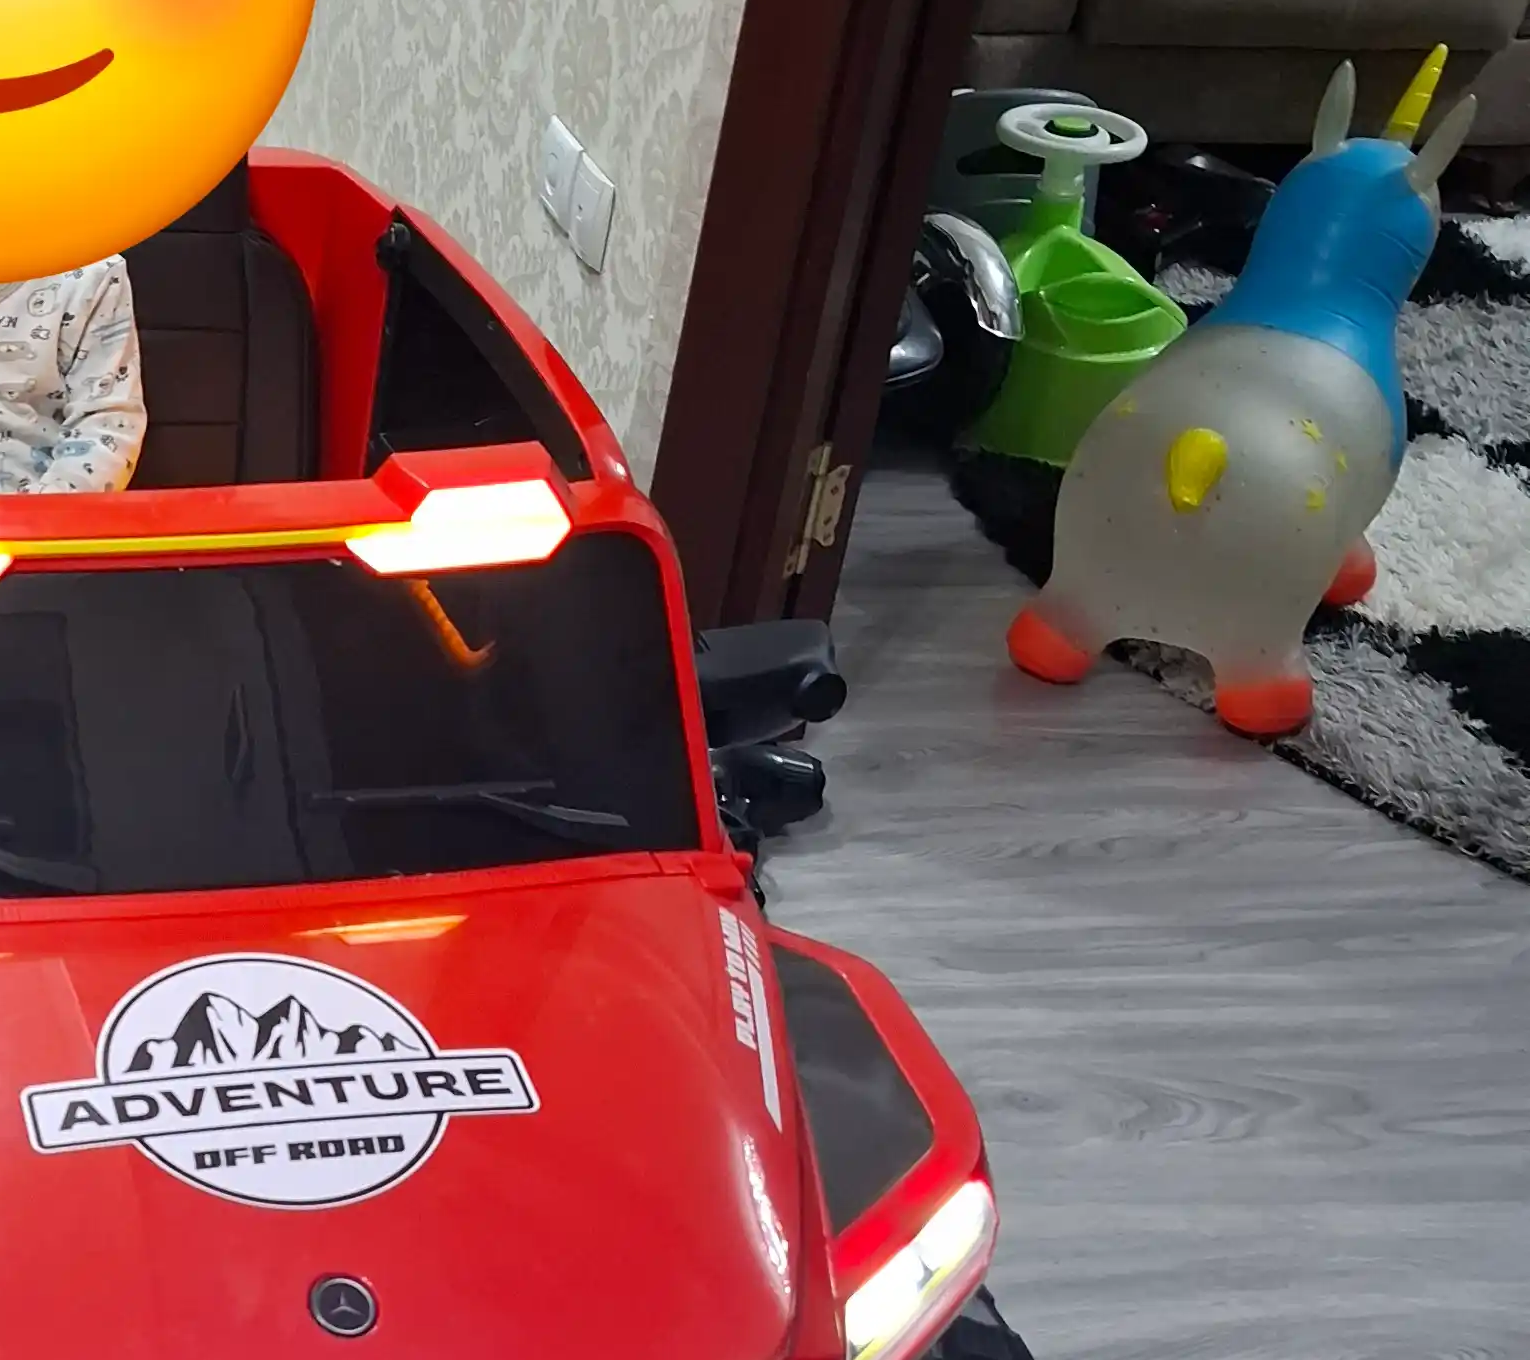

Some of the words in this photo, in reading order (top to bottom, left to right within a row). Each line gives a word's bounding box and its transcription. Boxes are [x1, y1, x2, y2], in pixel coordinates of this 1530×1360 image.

[60, 1067, 513, 1131] ADVENTURE
[193, 1143, 277, 1171] OFF
[287, 1134, 406, 1162] ROAD
